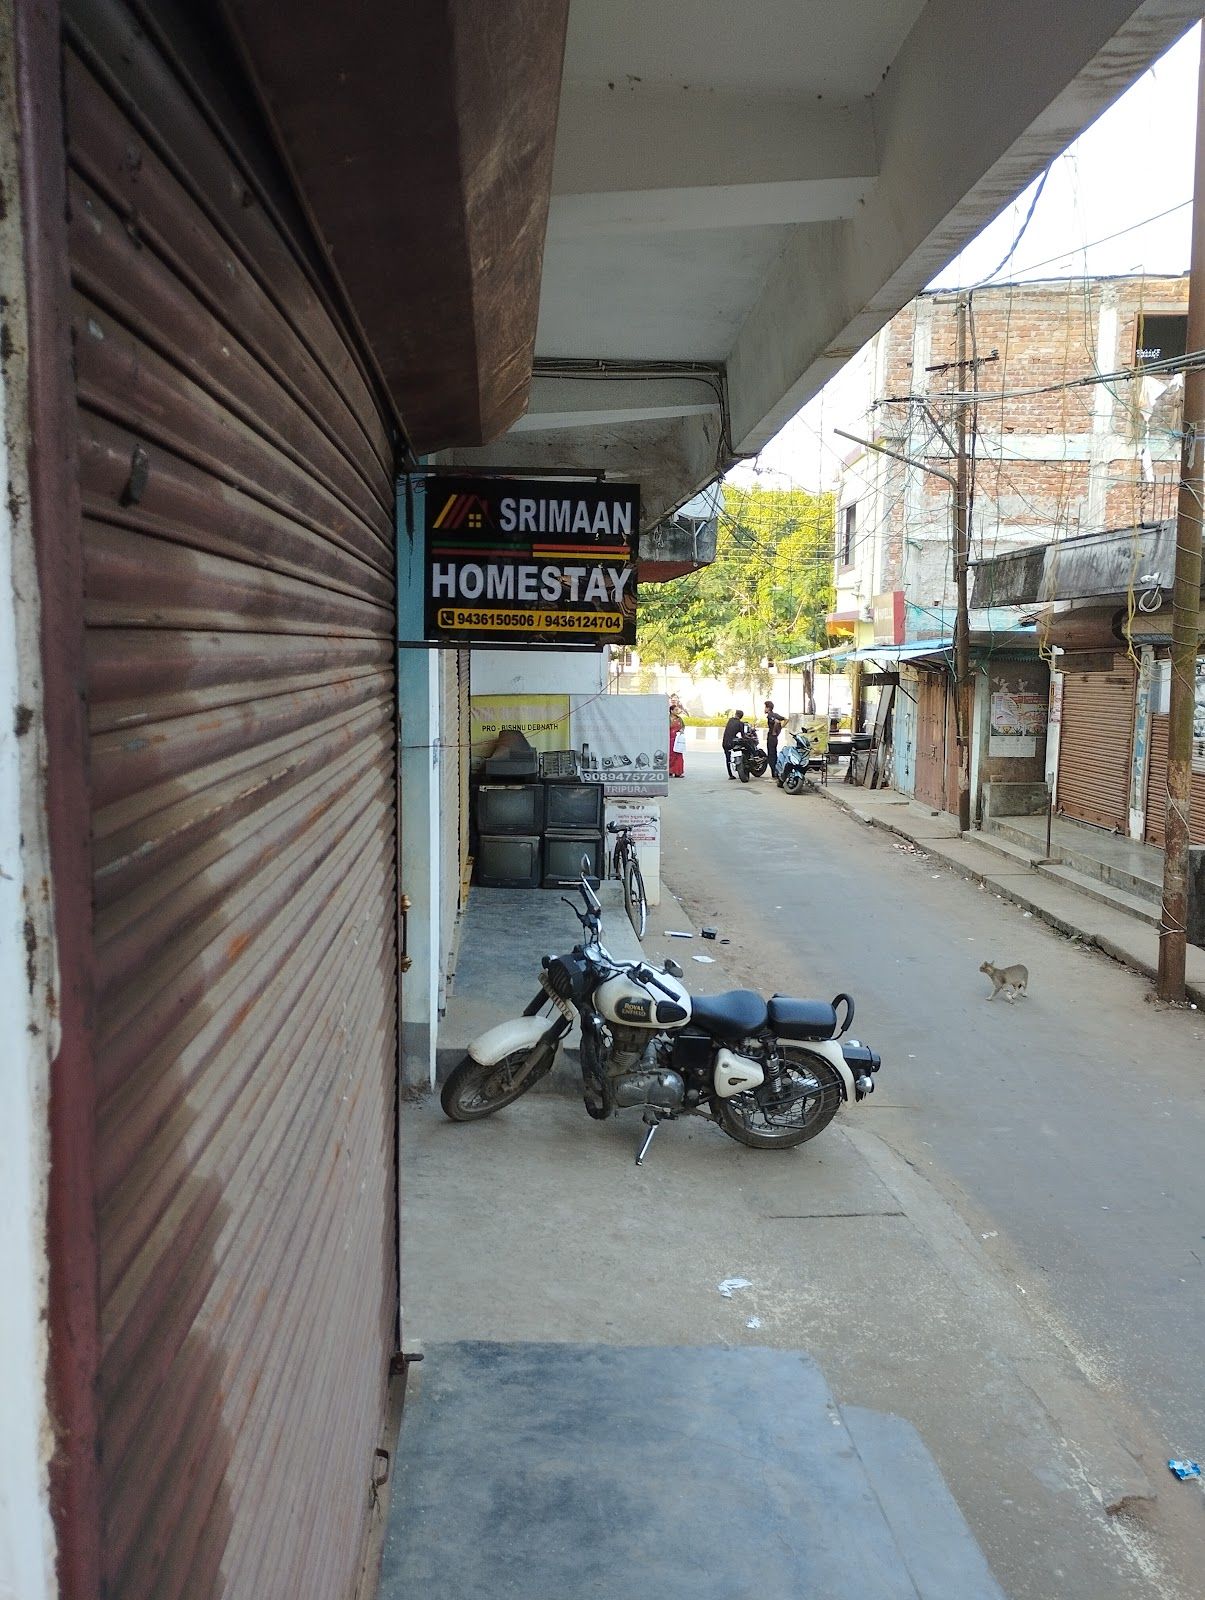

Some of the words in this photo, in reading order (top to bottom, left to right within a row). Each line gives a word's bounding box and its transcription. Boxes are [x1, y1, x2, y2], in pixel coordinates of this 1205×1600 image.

[500, 497, 632, 535] SRIMAAN
[432, 562, 632, 603] HOMESTAY
[457, 612, 534, 627] 9436150506
[545, 615, 621, 629] 9436124704
[527, 723, 559, 731] DEBNATH
[584, 772, 664, 781] 9089475720
[606, 785, 648, 793] TRIPURA
[624, 1003, 644, 1011] ROYAL
